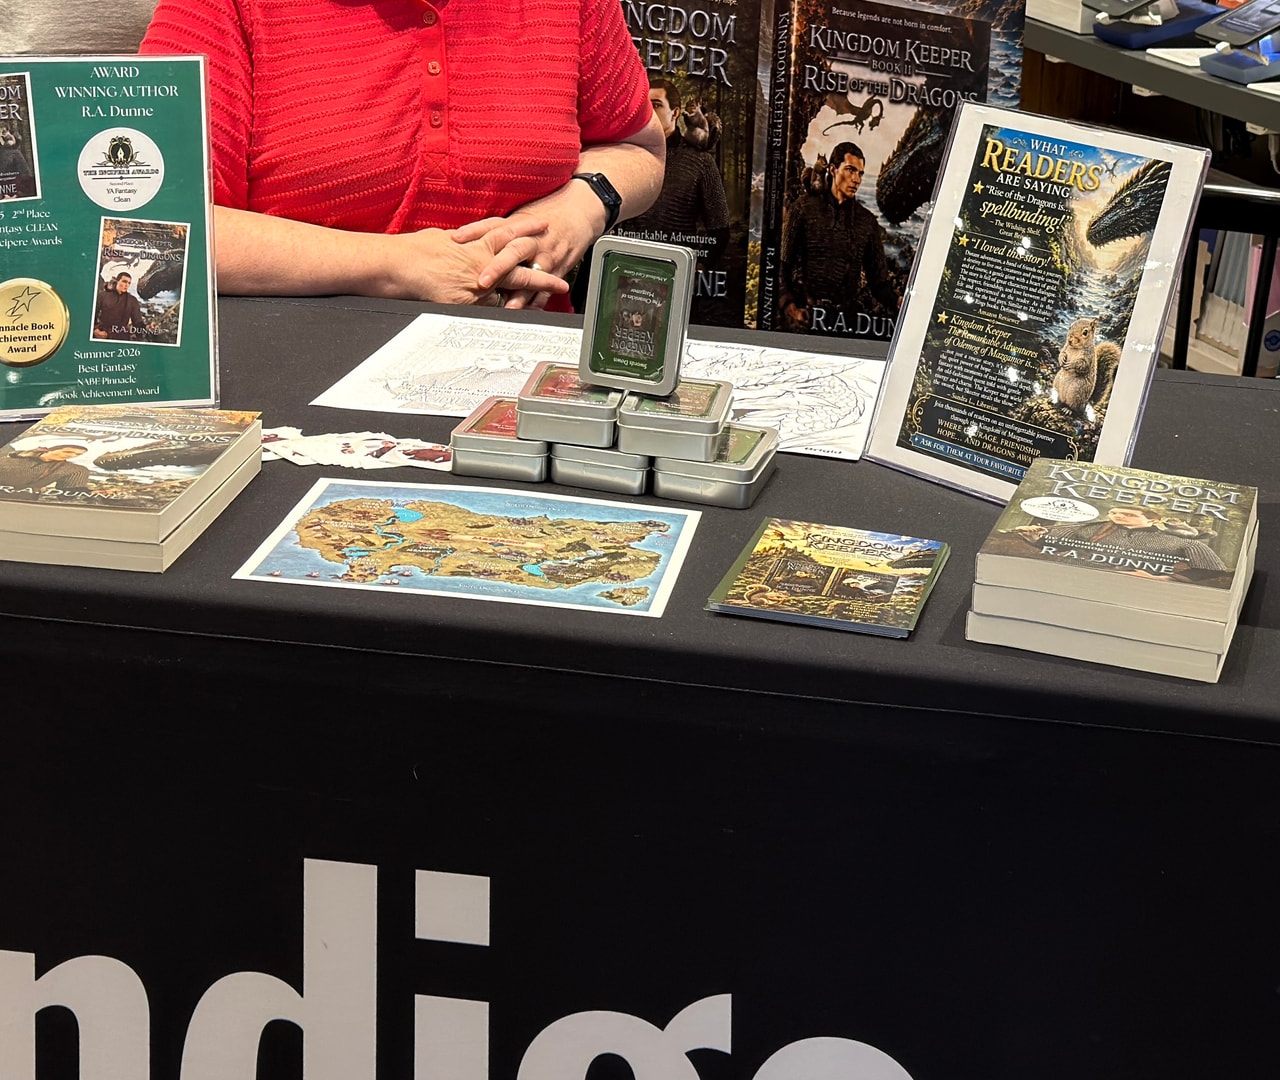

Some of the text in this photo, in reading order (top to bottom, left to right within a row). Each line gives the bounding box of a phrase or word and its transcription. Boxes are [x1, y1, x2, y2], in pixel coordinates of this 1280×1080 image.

[90, 66, 140, 78] AWARD
[55, 85, 179, 98] WINNING AUTHOR
[82, 105, 154, 117] R.A. Dunne
[1031, 139, 1067, 156] WHAT
[980, 138, 1102, 192] READERS
[996, 173, 1079, 201] ARE SAYING...
[12, 209, 25, 219] 2nd
[27, 209, 51, 218] Place
[26, 223, 58, 233] CLEAN
[30, 236, 63, 246] Awards
[31, 322, 55, 330] Book
[7, 345, 37, 354] Award
